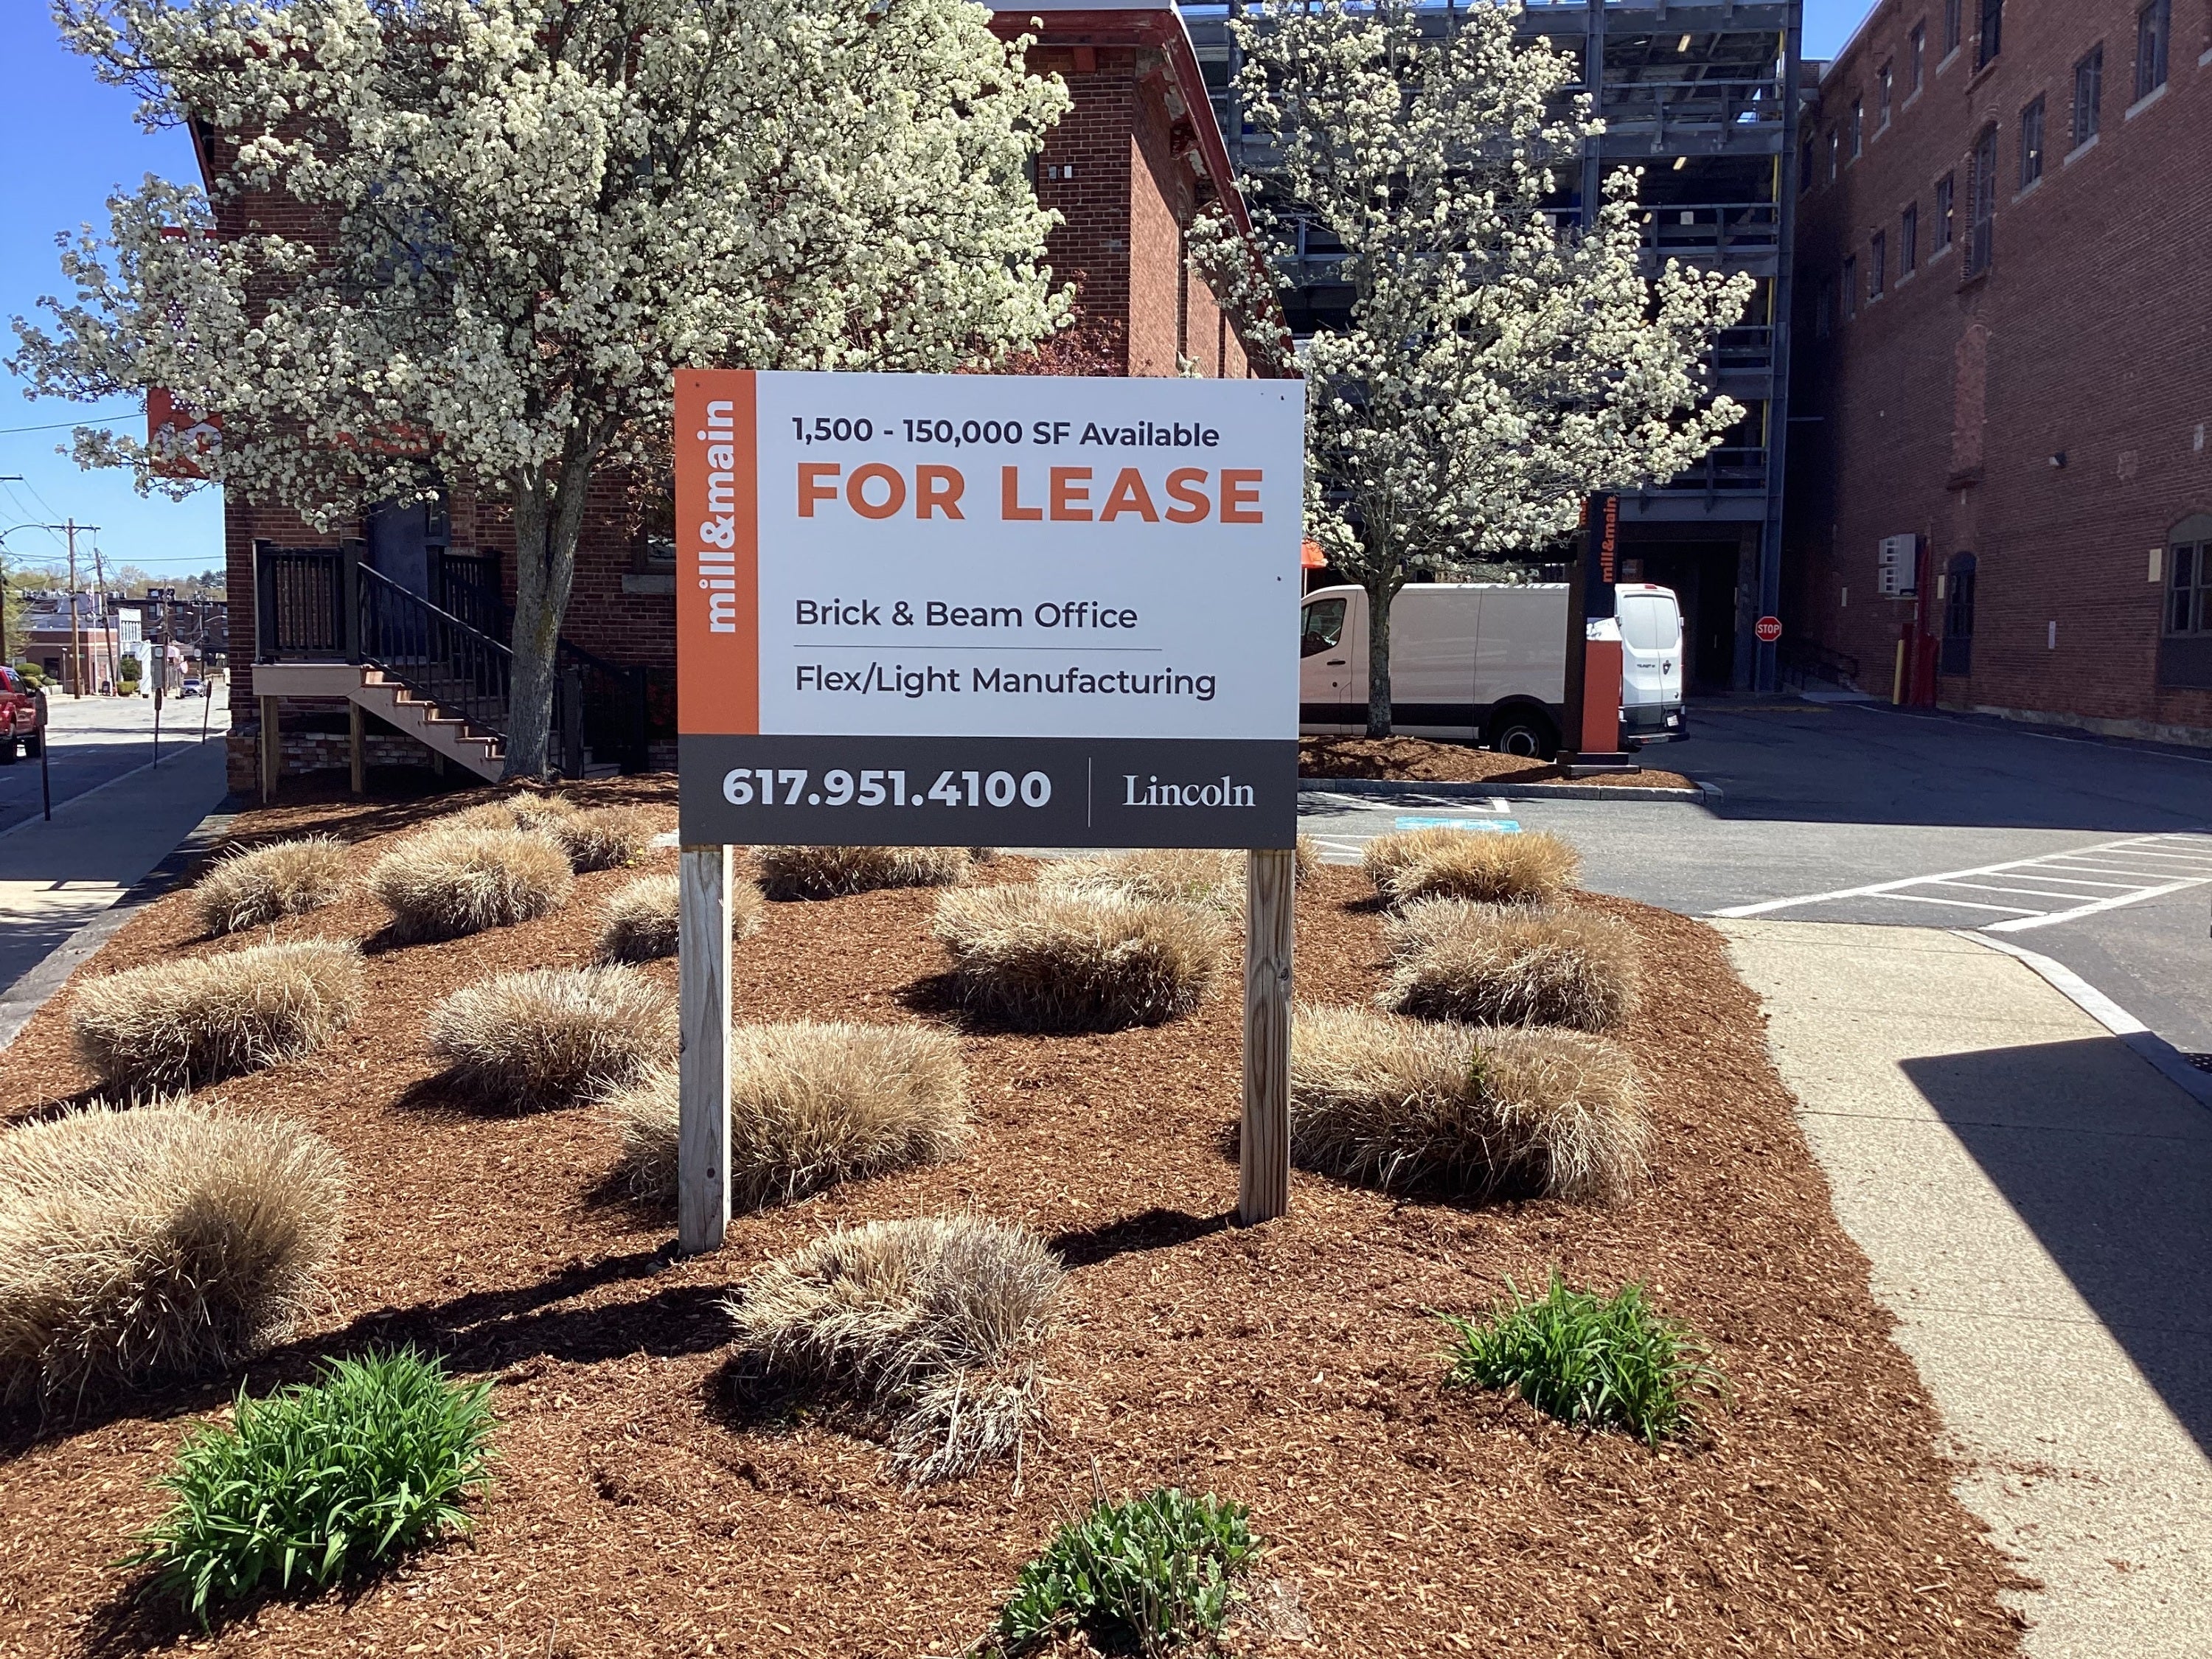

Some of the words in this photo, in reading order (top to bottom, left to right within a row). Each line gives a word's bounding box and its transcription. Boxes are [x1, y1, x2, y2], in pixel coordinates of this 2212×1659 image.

[793, 417, 872, 445] 1,500
[903, 420, 1022, 448] 150,000
[1033, 422, 1071, 444] SF
[1079, 421, 1219, 447] Available
[799, 464, 964, 519] FOR
[1003, 467, 1262, 523] LEASE
[697, 401, 736, 633] mill&main
[1601, 495, 1616, 582] mill&main
[796, 598, 881, 625] Brick
[892, 601, 914, 625] &
[927, 602, 1022, 627] Beam
[1035, 601, 1137, 628] Office
[1757, 624, 1780, 634] STOP
[797, 662, 960, 698] Flex/Light
[973, 667, 1215, 700] Manufacturing
[723, 769, 1051, 807] 617.951.4100
[1123, 776, 1256, 806] Lincoln
